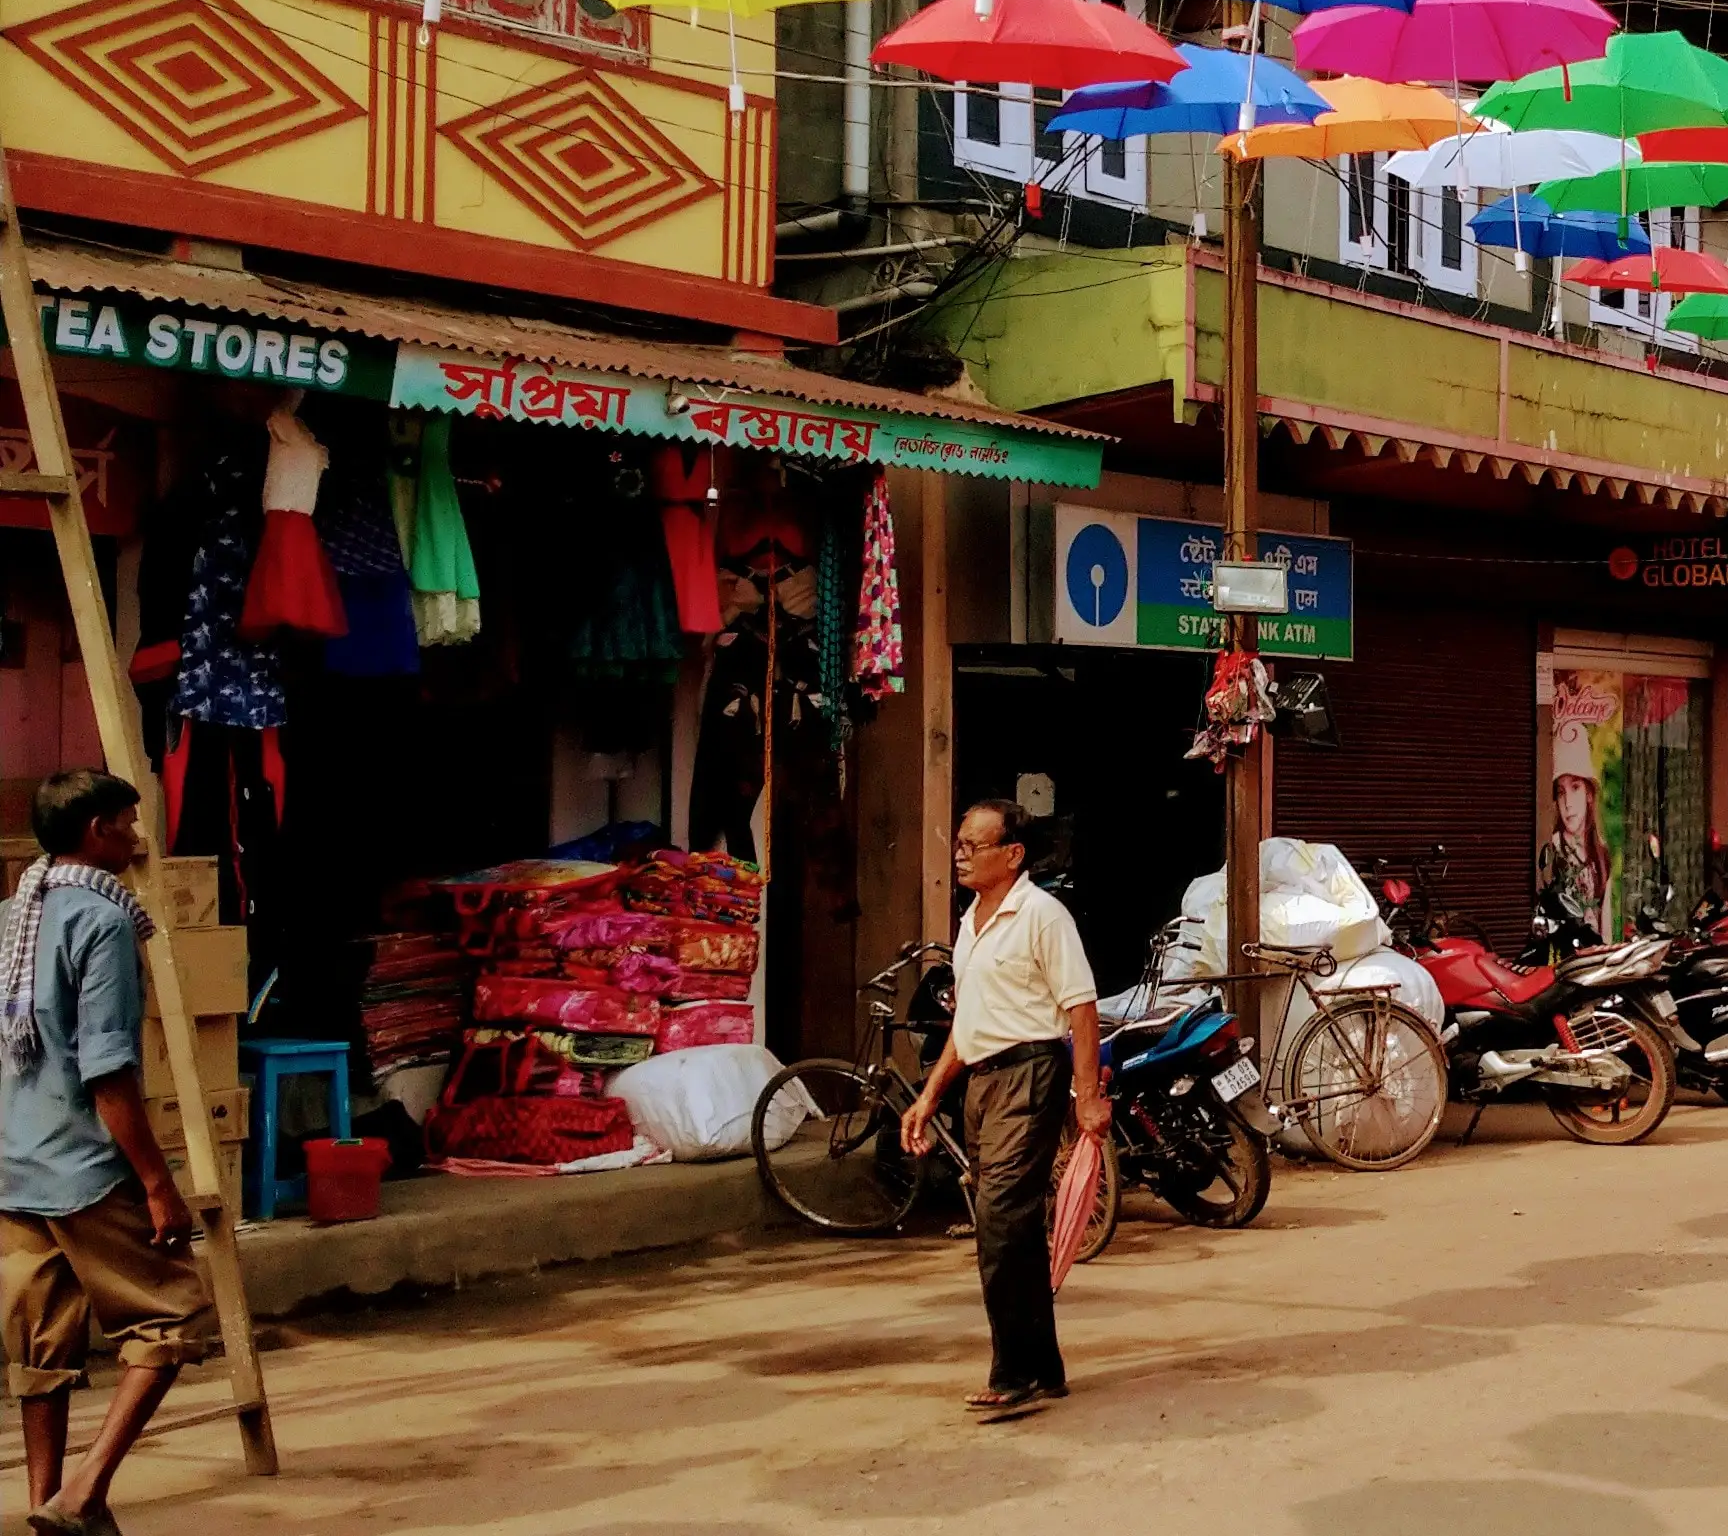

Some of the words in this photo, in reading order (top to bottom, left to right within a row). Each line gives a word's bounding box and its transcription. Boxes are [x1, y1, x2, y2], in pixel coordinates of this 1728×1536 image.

[146, 314, 349, 385] STORES
[438, 354, 631, 429] সুপ্রিয়া
[1652, 537, 1728, 560] HOTEL
[1283, 623, 1316, 644] ATM
